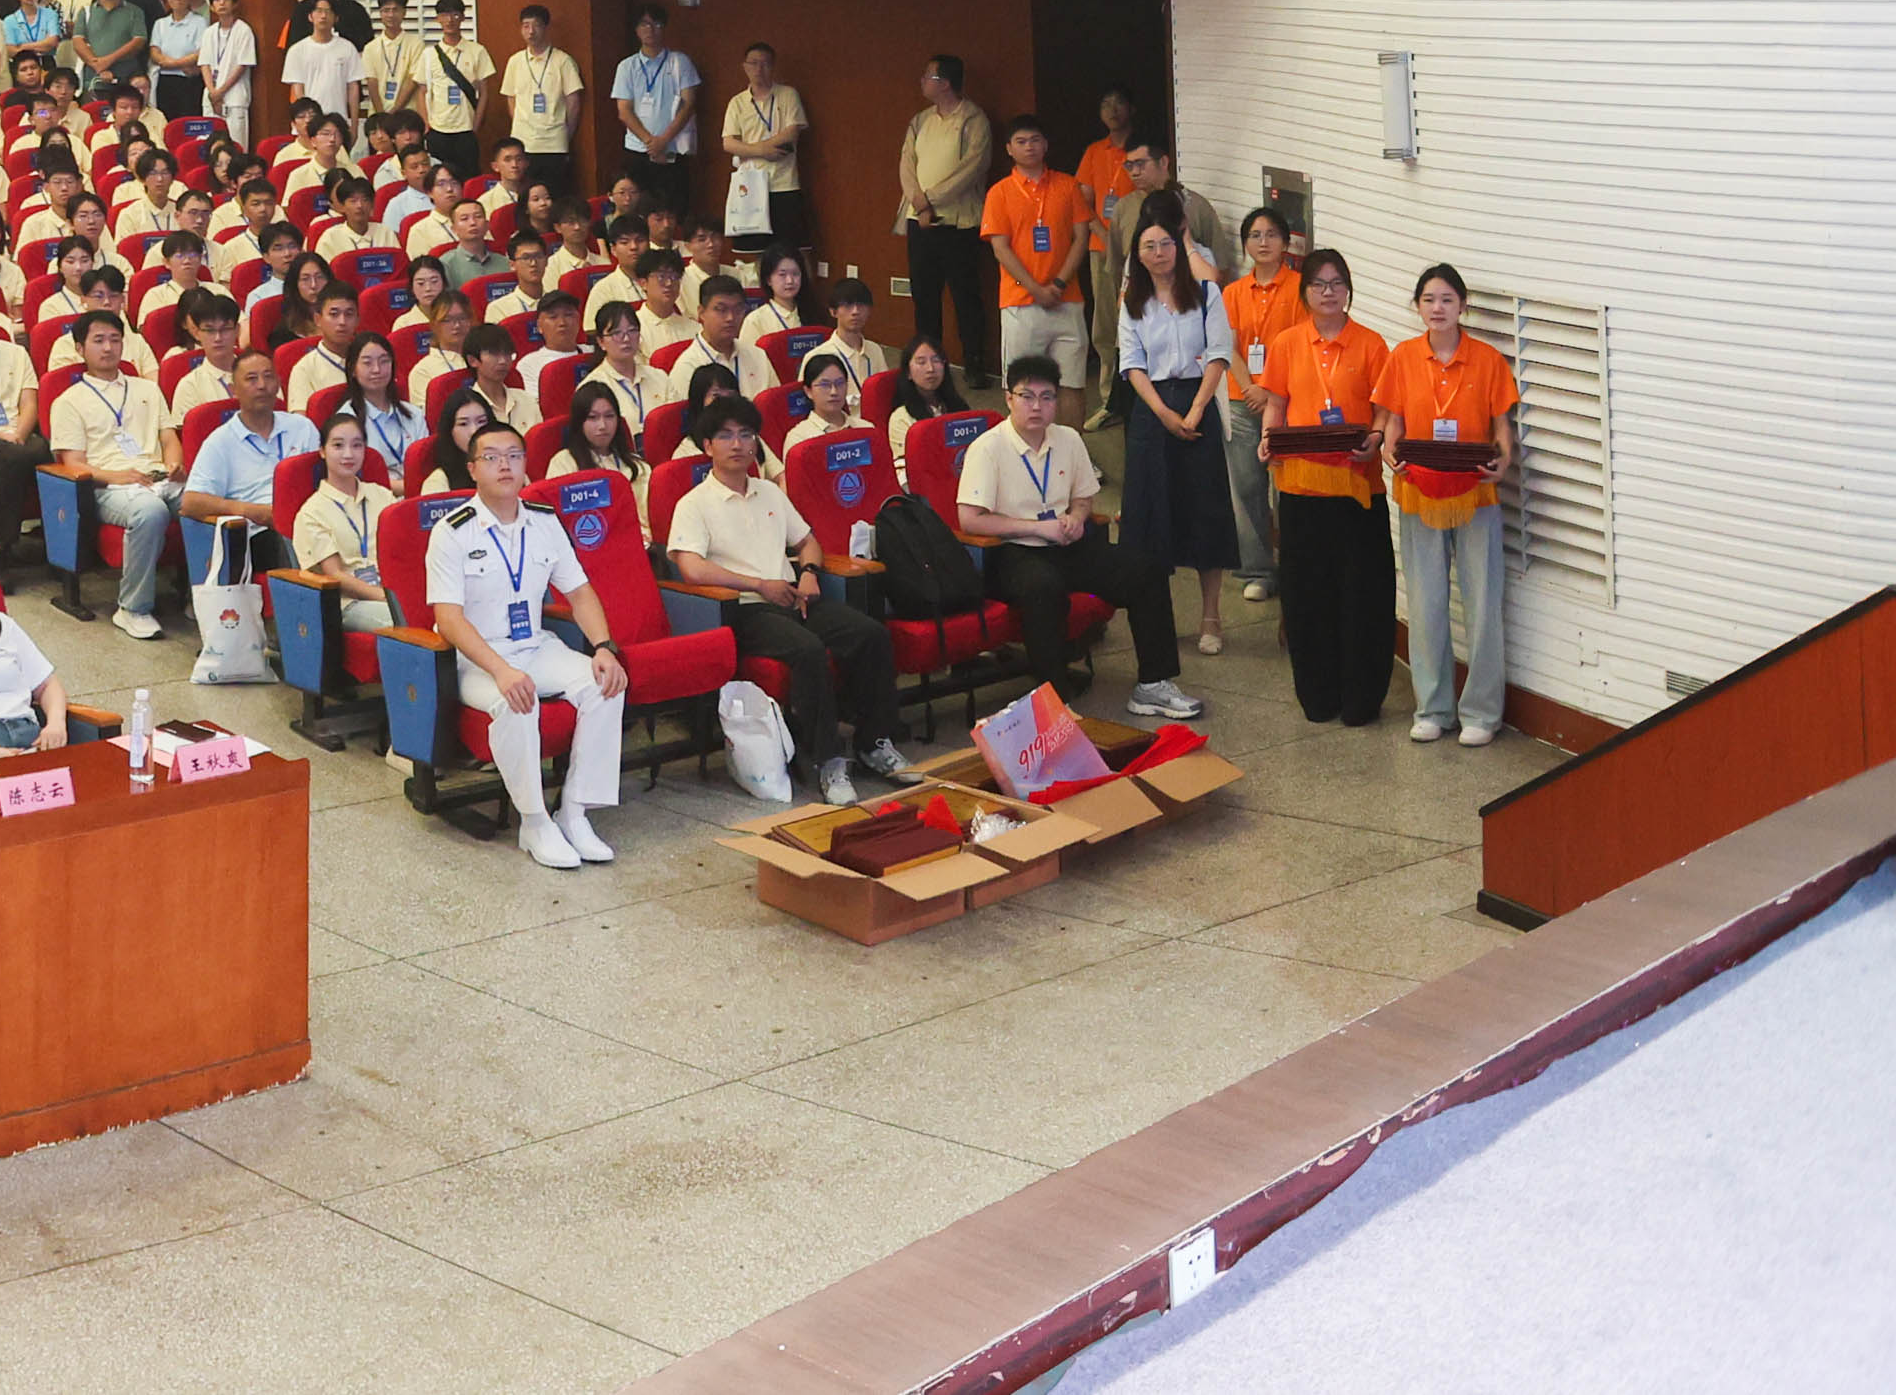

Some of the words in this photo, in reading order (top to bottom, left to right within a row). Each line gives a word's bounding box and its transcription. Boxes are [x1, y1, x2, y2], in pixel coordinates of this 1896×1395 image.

[954, 424, 978, 437] D01-1
[836, 448, 861, 461] D01-2
[571, 489, 599, 503] D01-4
